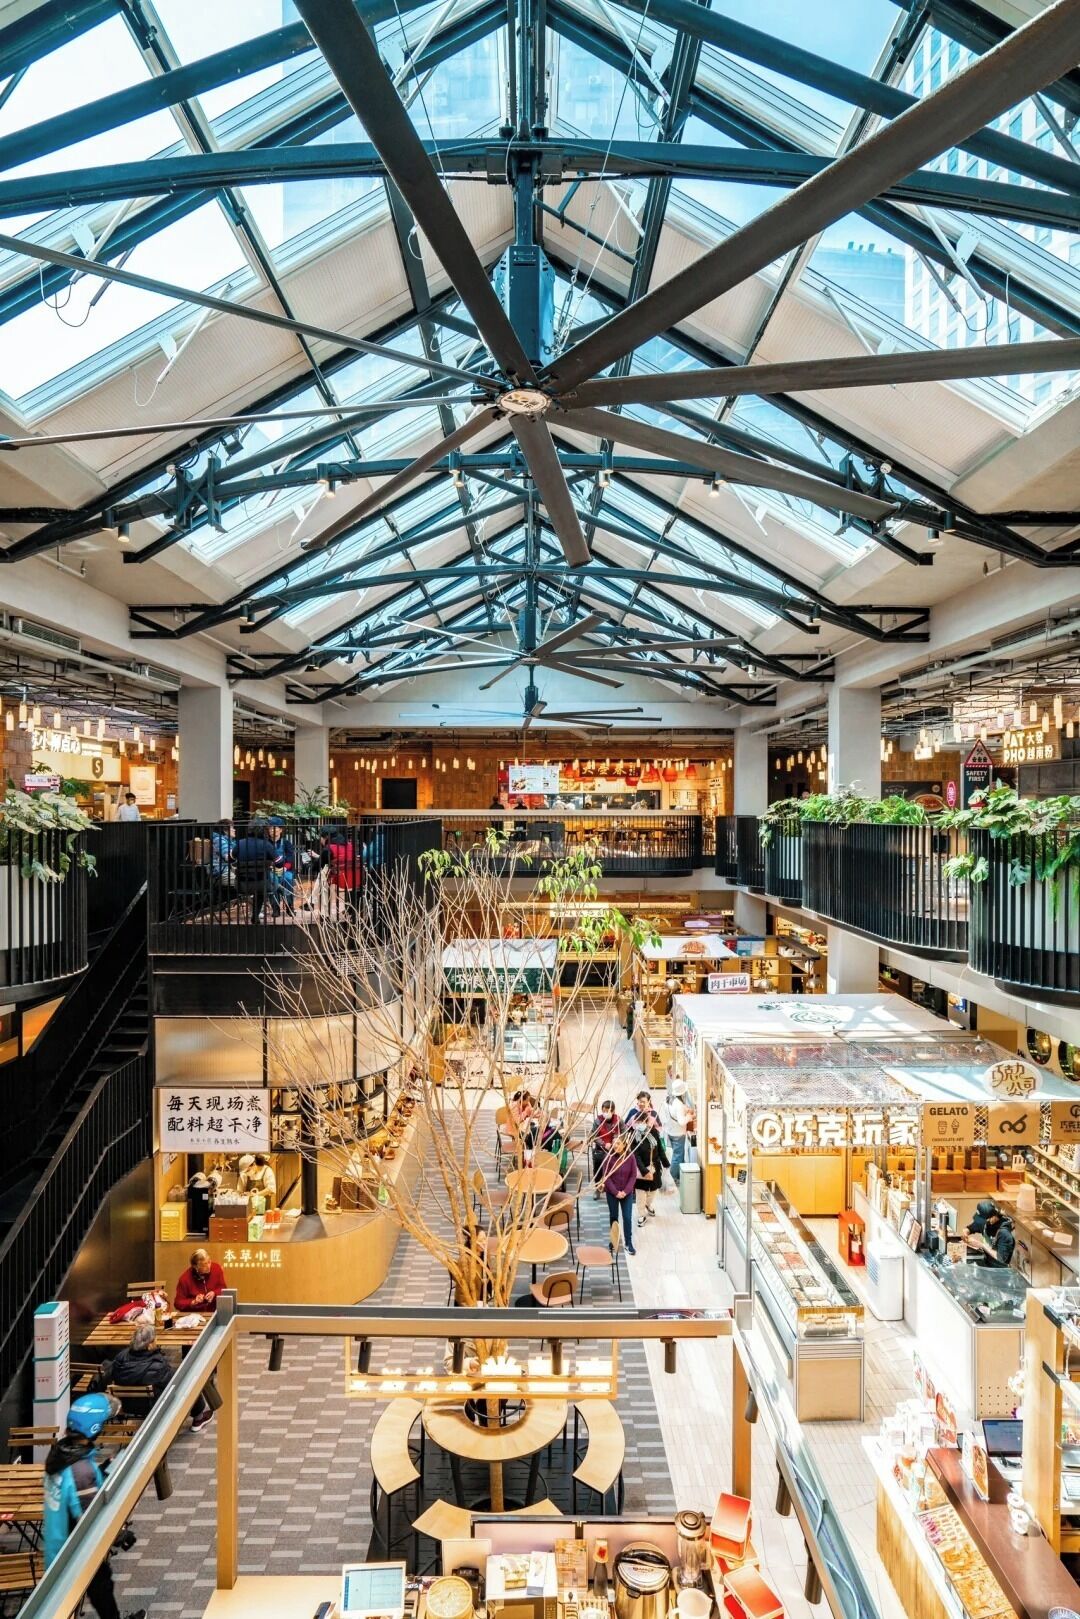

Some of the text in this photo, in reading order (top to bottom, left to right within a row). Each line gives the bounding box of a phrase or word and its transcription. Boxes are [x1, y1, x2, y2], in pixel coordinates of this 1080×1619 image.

[1003, 748, 1026, 763] PHO
[1027, 745, 1053, 760] 越南粉
[1006, 1076, 1036, 1097] 公司
[167, 1095, 262, 1111] 每天现场煮
[929, 1107, 969, 1116] GELATO
[167, 1115, 262, 1133] 配料超干净
[780, 1113, 919, 1146] 巧克玩家
[223, 1249, 281, 1262] 本草小匠
